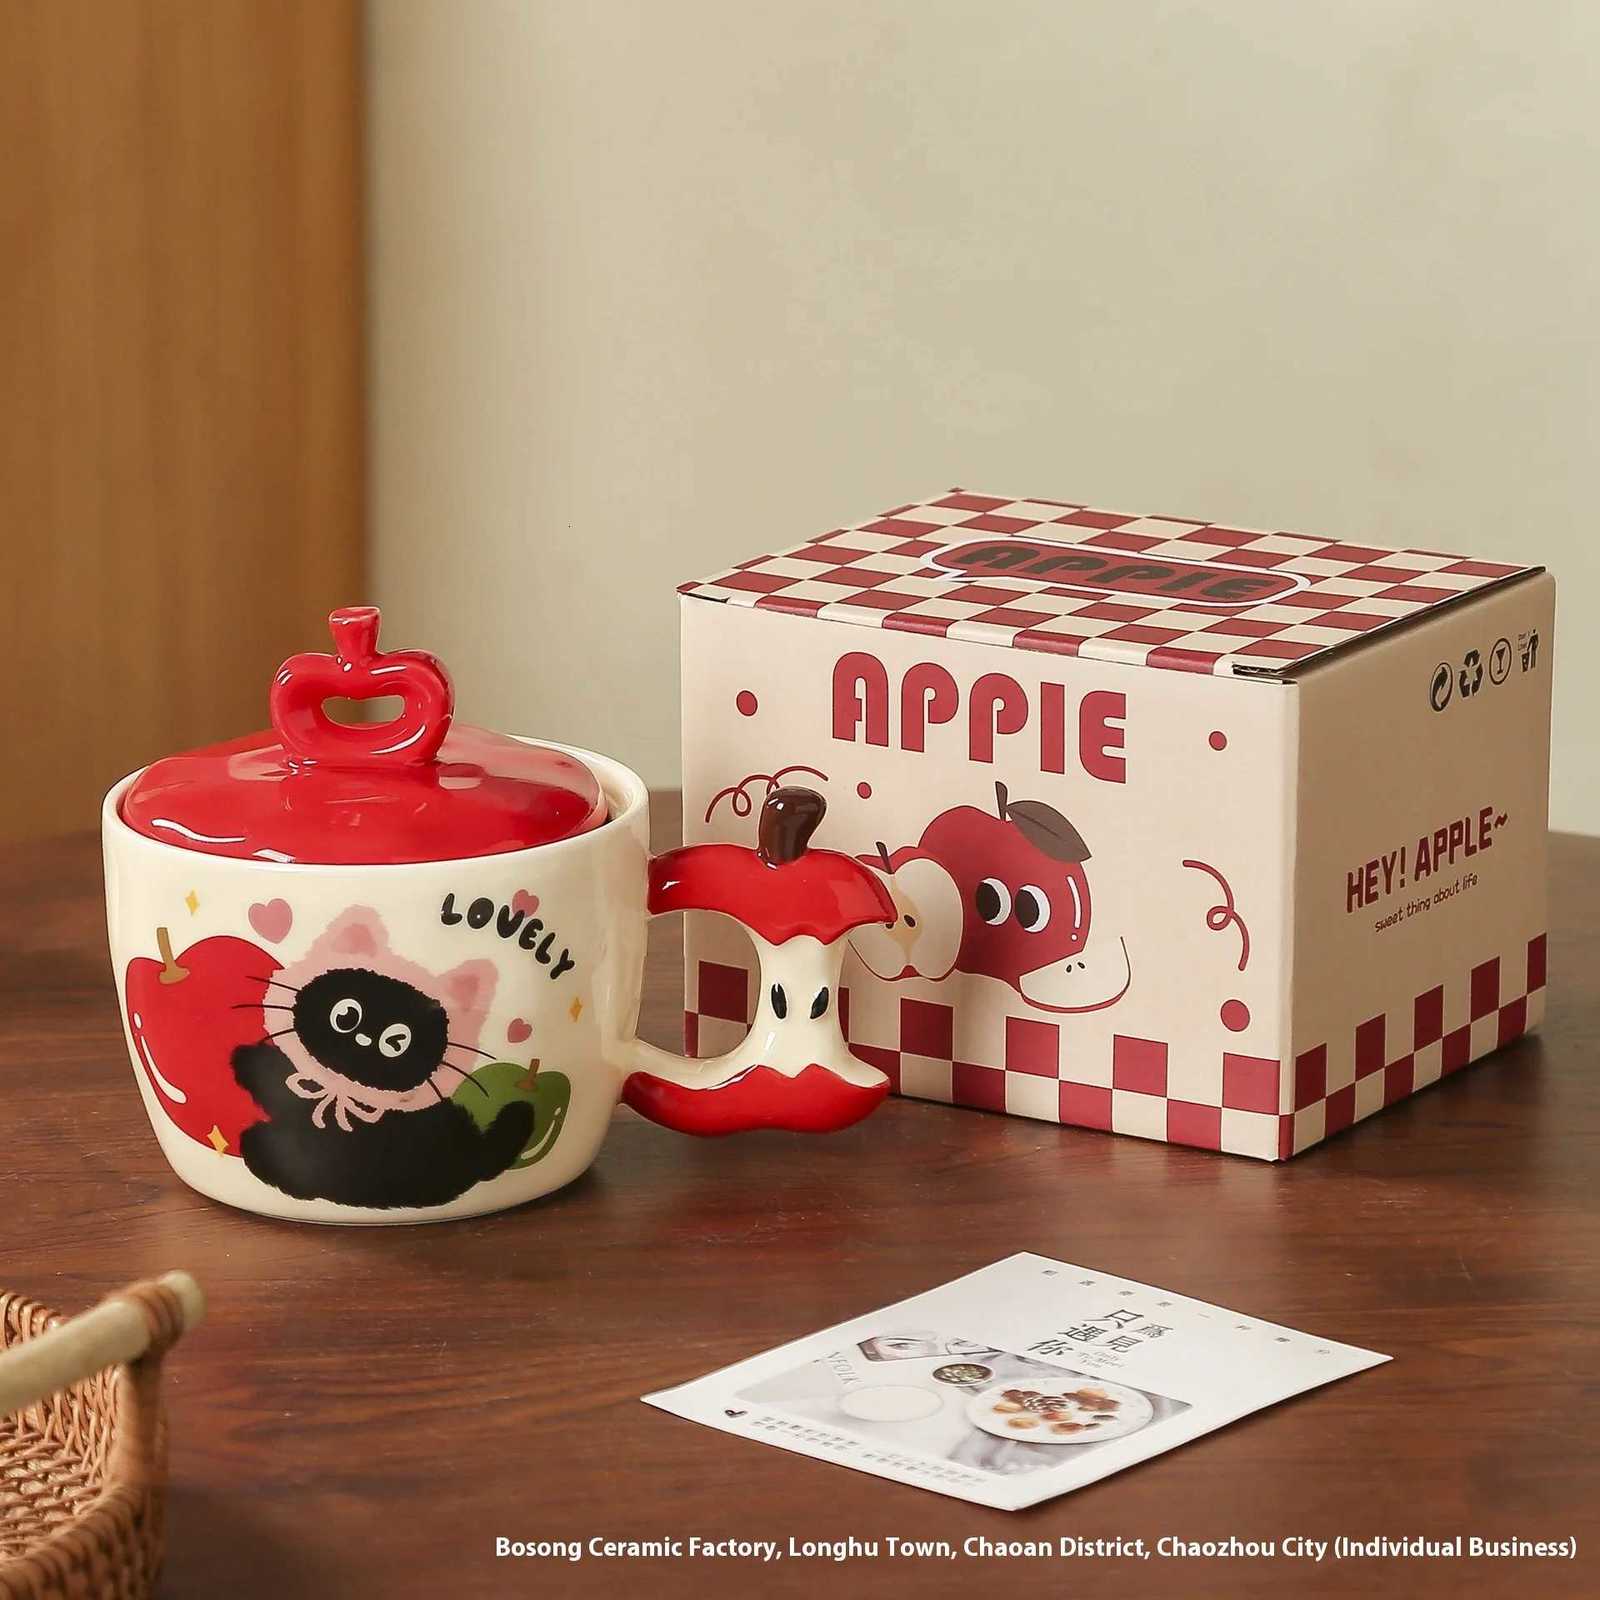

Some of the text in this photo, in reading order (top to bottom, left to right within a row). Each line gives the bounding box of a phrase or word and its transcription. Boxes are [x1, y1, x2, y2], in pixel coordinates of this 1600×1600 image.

[1346, 846, 1407, 914] HEY!
[1375, 872, 1478, 933] sweet thing about life
[441, 892, 576, 980] LOVELY
